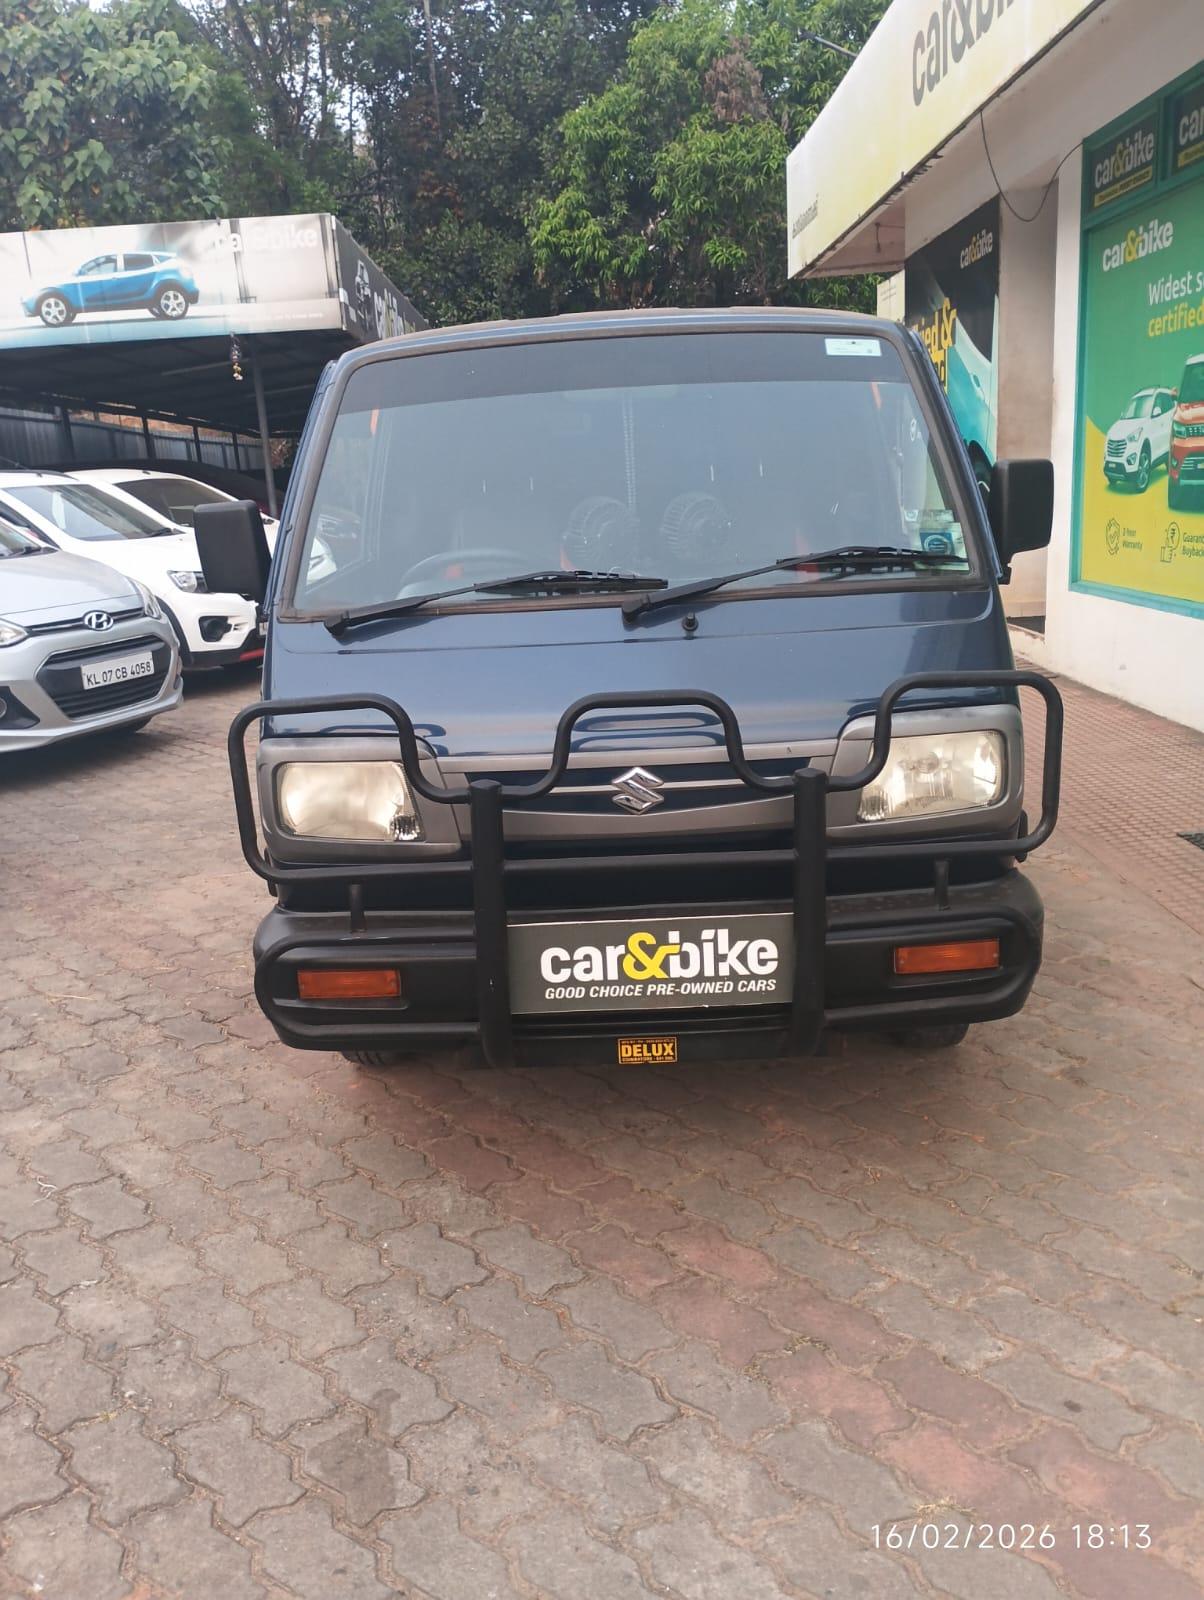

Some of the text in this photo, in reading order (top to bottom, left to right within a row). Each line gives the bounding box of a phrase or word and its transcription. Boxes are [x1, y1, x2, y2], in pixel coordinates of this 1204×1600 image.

[1095, 130, 1154, 189] car&bike
[960, 229, 993, 269] car&bike
[1102, 219, 1174, 272] car&bike
[1148, 270, 1204, 306] Widest s
[1148, 297, 1204, 337] certified
[86, 661, 152, 686] KL 07 CB 4058
[540, 928, 779, 984] car&bike
[545, 979, 777, 1000] GOOD CHOICE PRE-OWNED CARS
[621, 1043, 675, 1058] DELUX
